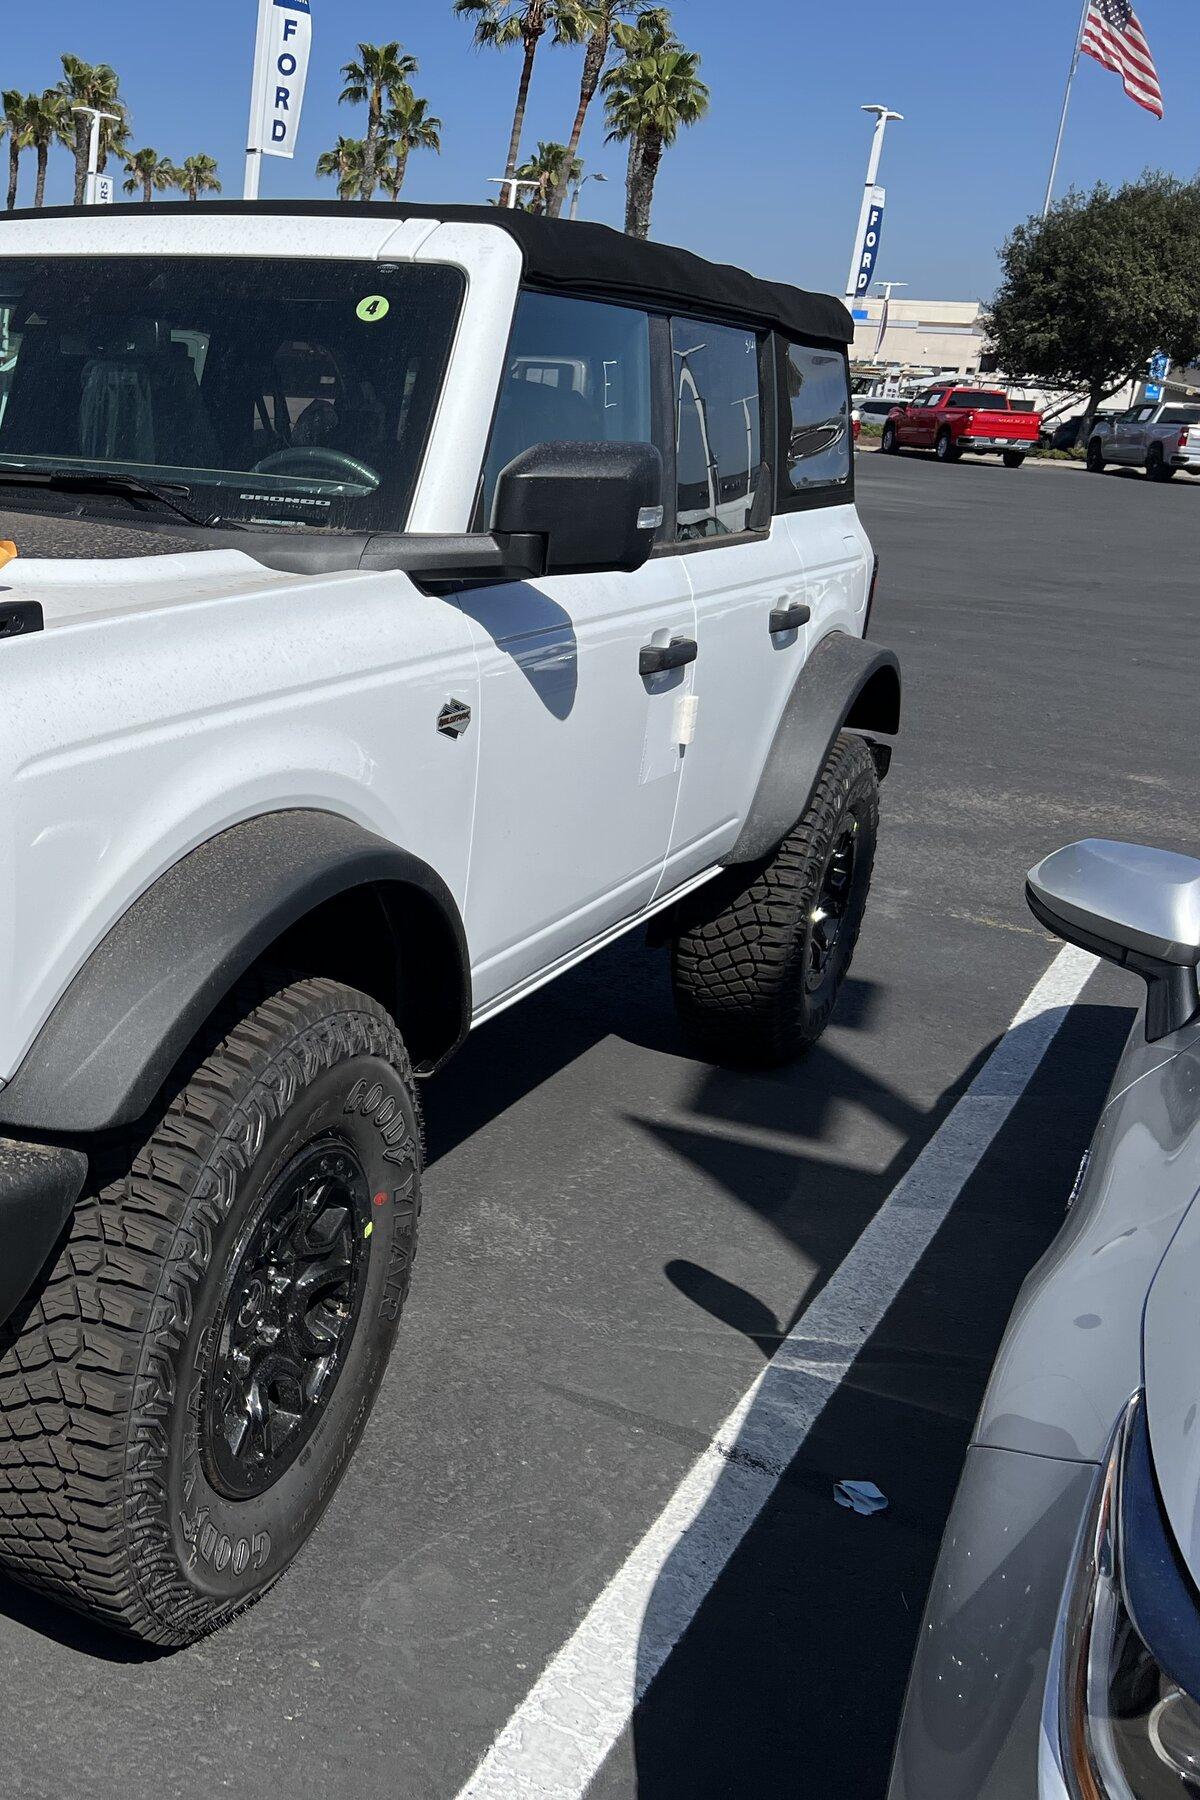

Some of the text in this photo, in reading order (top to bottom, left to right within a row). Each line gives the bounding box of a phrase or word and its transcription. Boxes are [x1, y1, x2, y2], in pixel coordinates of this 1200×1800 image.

[271, 18, 298, 143] FORD
[857, 210, 879, 289] FORD
[364, 300, 380, 315] 4
[240, 493, 331, 507] BRONCO
